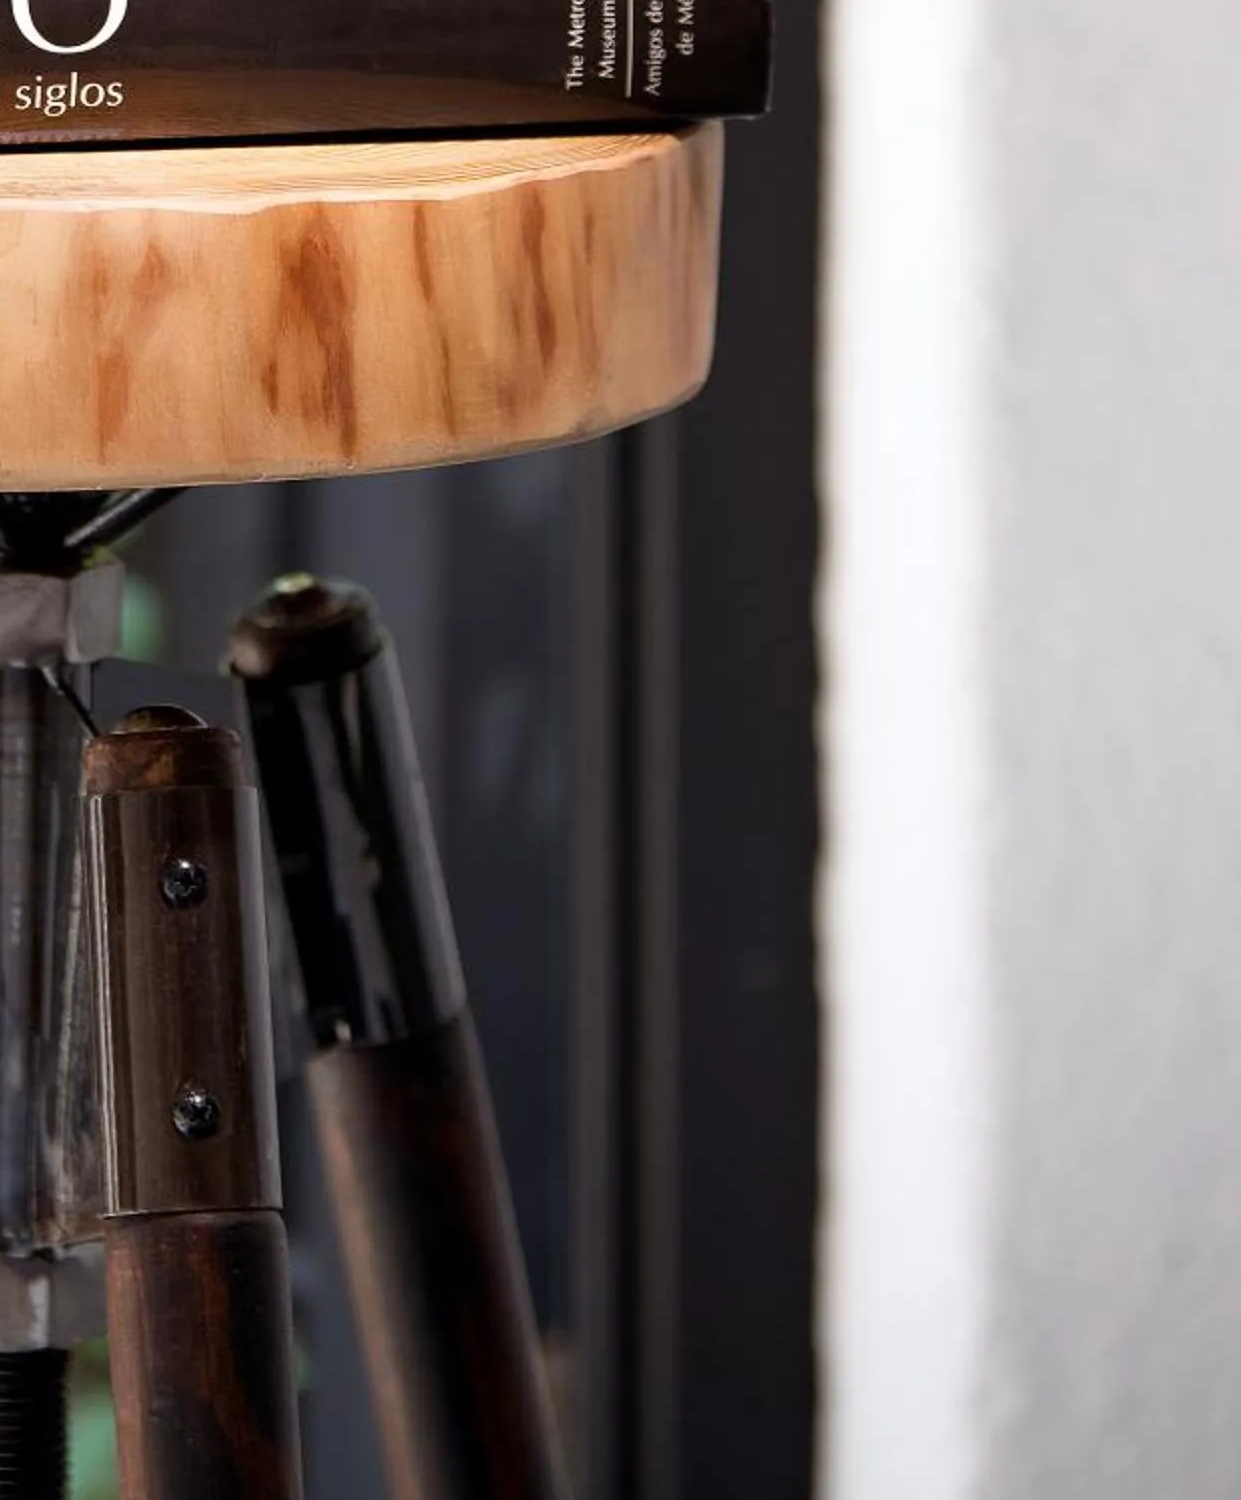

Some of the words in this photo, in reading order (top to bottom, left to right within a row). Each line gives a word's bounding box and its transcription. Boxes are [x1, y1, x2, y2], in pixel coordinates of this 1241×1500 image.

[644, 0, 664, 24] de
[599, 0, 616, 79] Museum
[675, 31, 694, 56] de
[565, 55, 585, 91] The
[643, 28, 667, 97] Amigos
[15, 72, 124, 117] siglos
